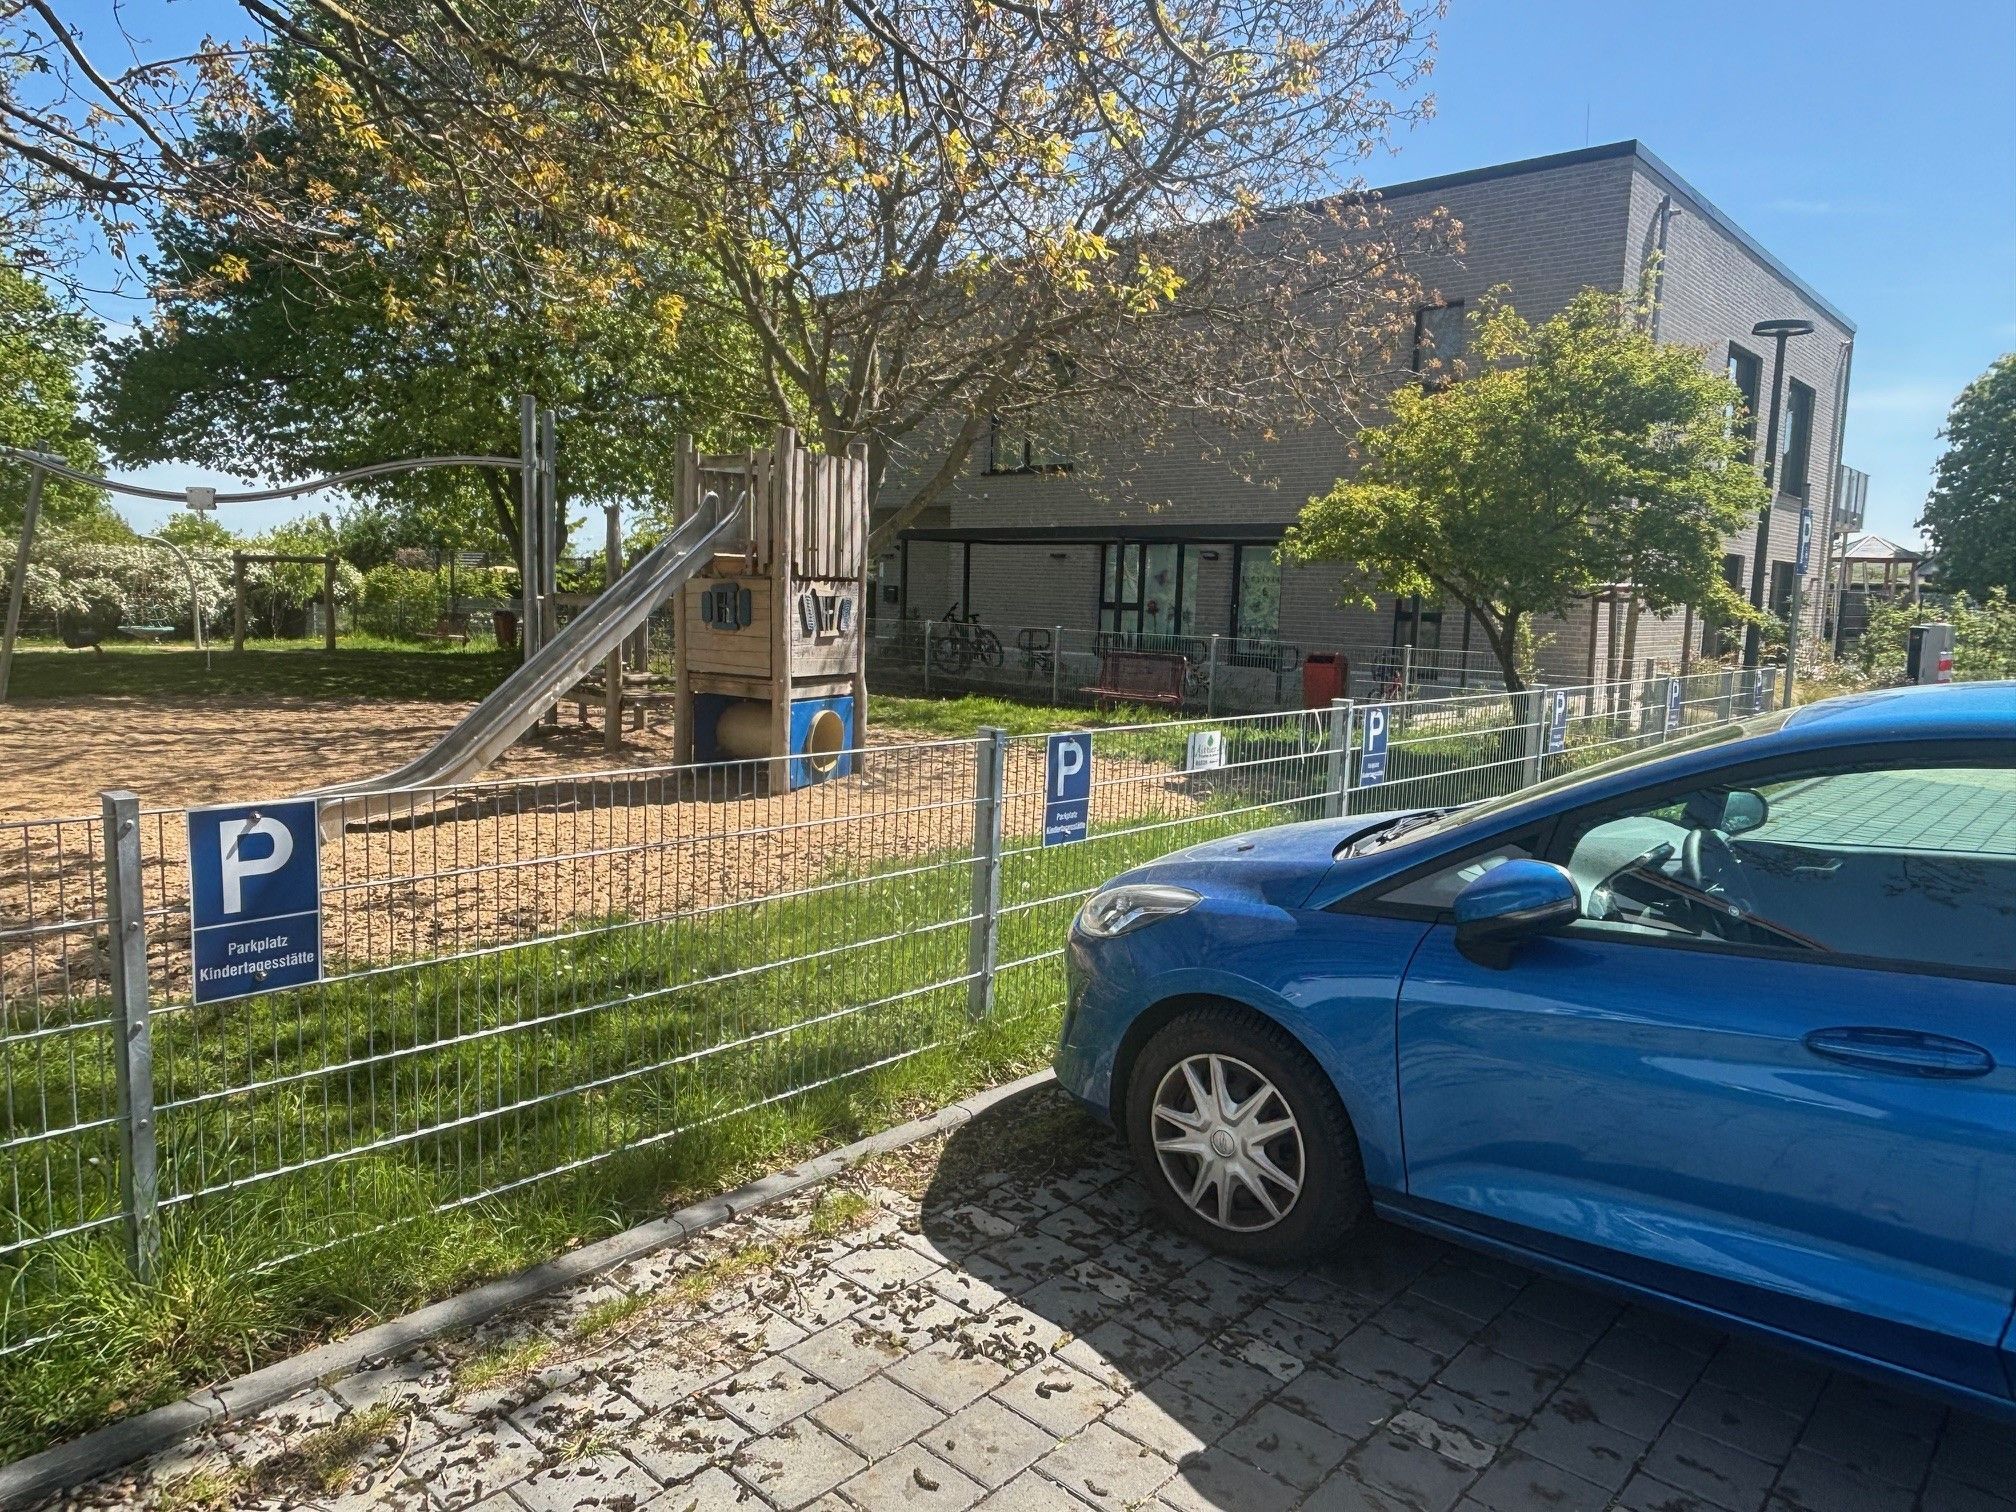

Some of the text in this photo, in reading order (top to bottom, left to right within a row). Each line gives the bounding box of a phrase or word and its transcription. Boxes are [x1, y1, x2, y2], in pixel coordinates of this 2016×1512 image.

[1555, 693, 1565, 725] P
[1368, 711, 1384, 751] P
[1057, 741, 1084, 796] P
[219, 816, 294, 914] P
[228, 935, 288, 956] Parkplatz
[200, 951, 314, 982] Kindertagesstätte
